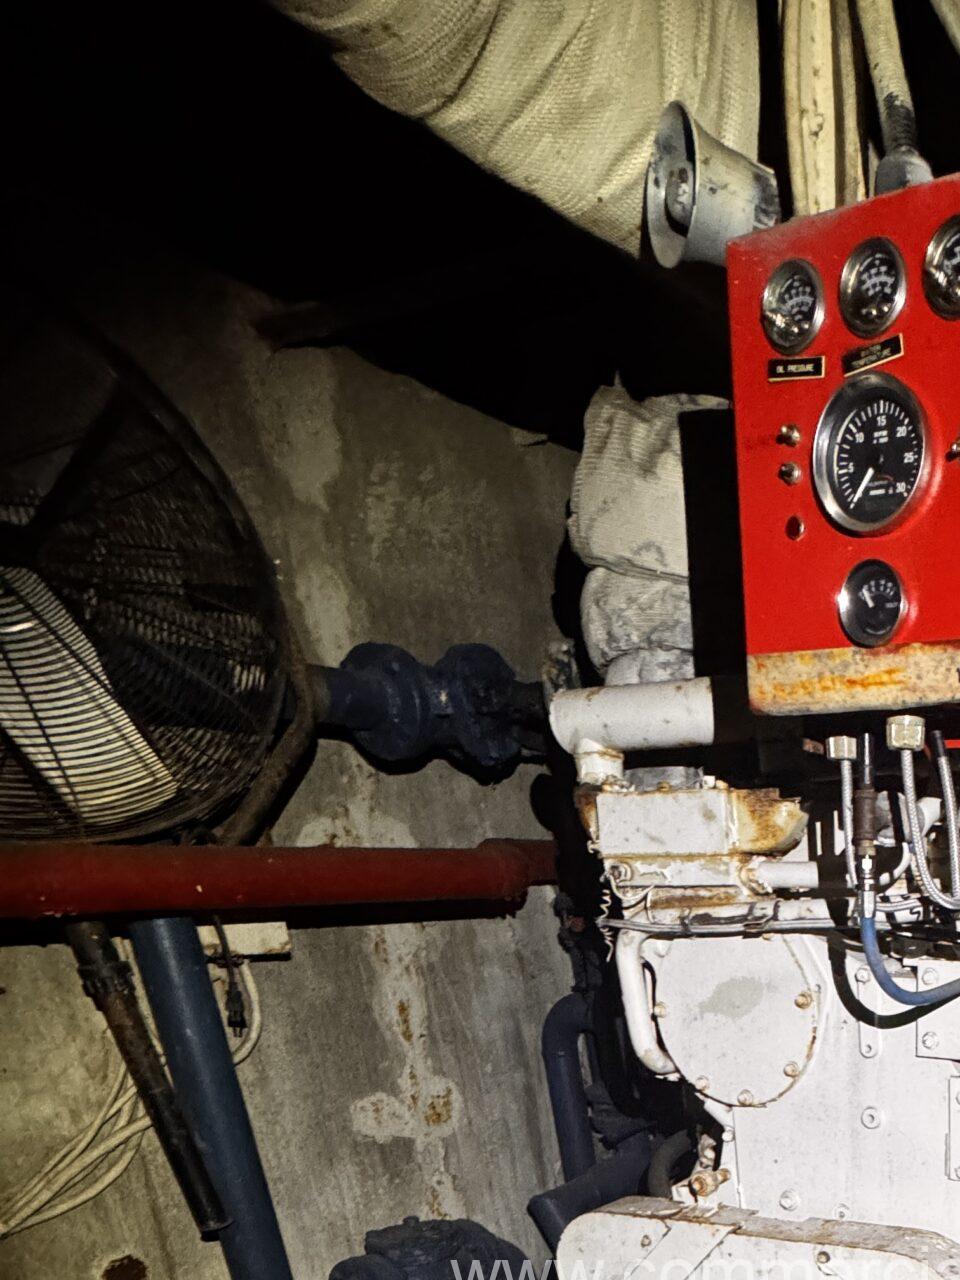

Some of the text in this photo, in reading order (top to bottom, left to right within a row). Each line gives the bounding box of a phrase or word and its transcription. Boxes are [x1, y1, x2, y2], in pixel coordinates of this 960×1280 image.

[876, 415, 887, 427] 15
[896, 426, 907, 437] 20
[855, 433, 865, 443] 10
[904, 452, 914, 463] 25
[848, 462, 854, 473] 5
[896, 482, 906, 493] 30
